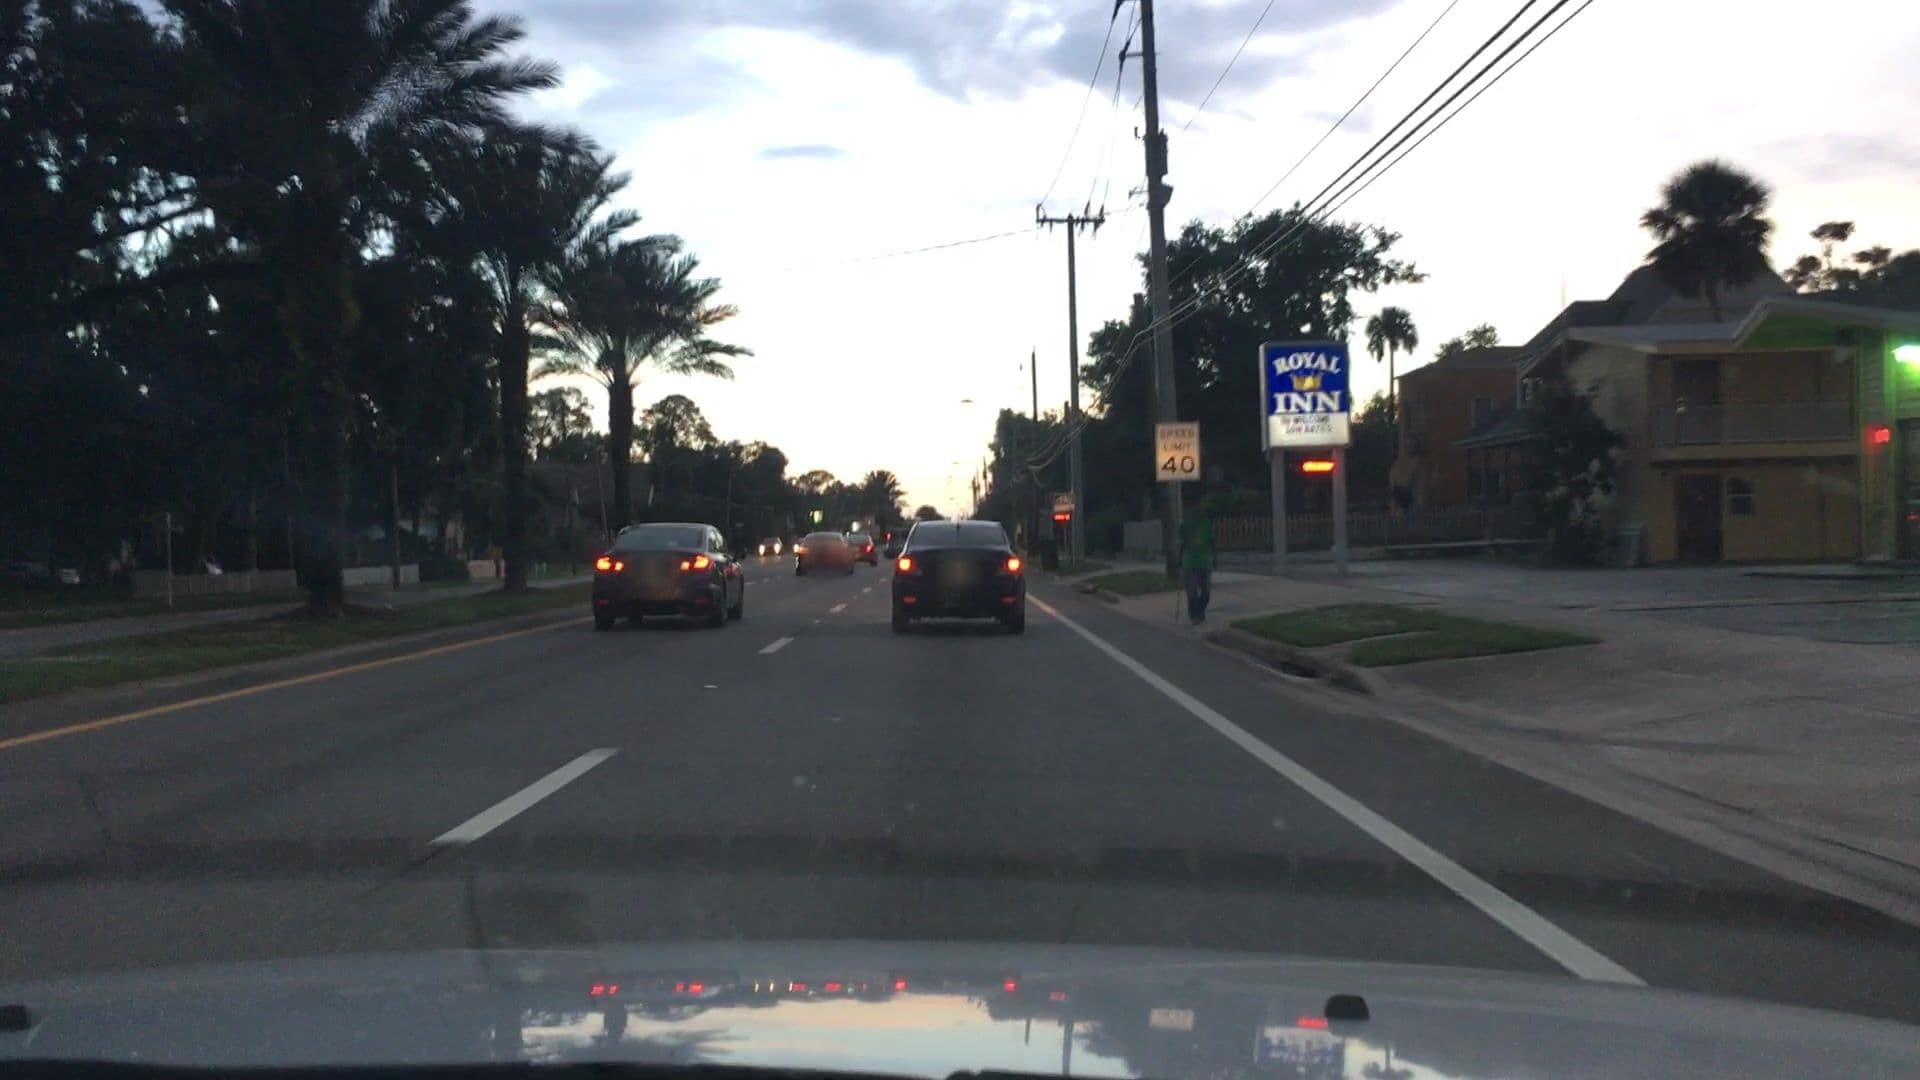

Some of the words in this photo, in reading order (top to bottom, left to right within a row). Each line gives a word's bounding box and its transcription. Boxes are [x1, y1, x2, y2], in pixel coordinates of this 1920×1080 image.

[1272, 352, 1341, 376] ROYAL
[1273, 391, 1341, 413] INN
[1161, 456, 1195, 474] 40
